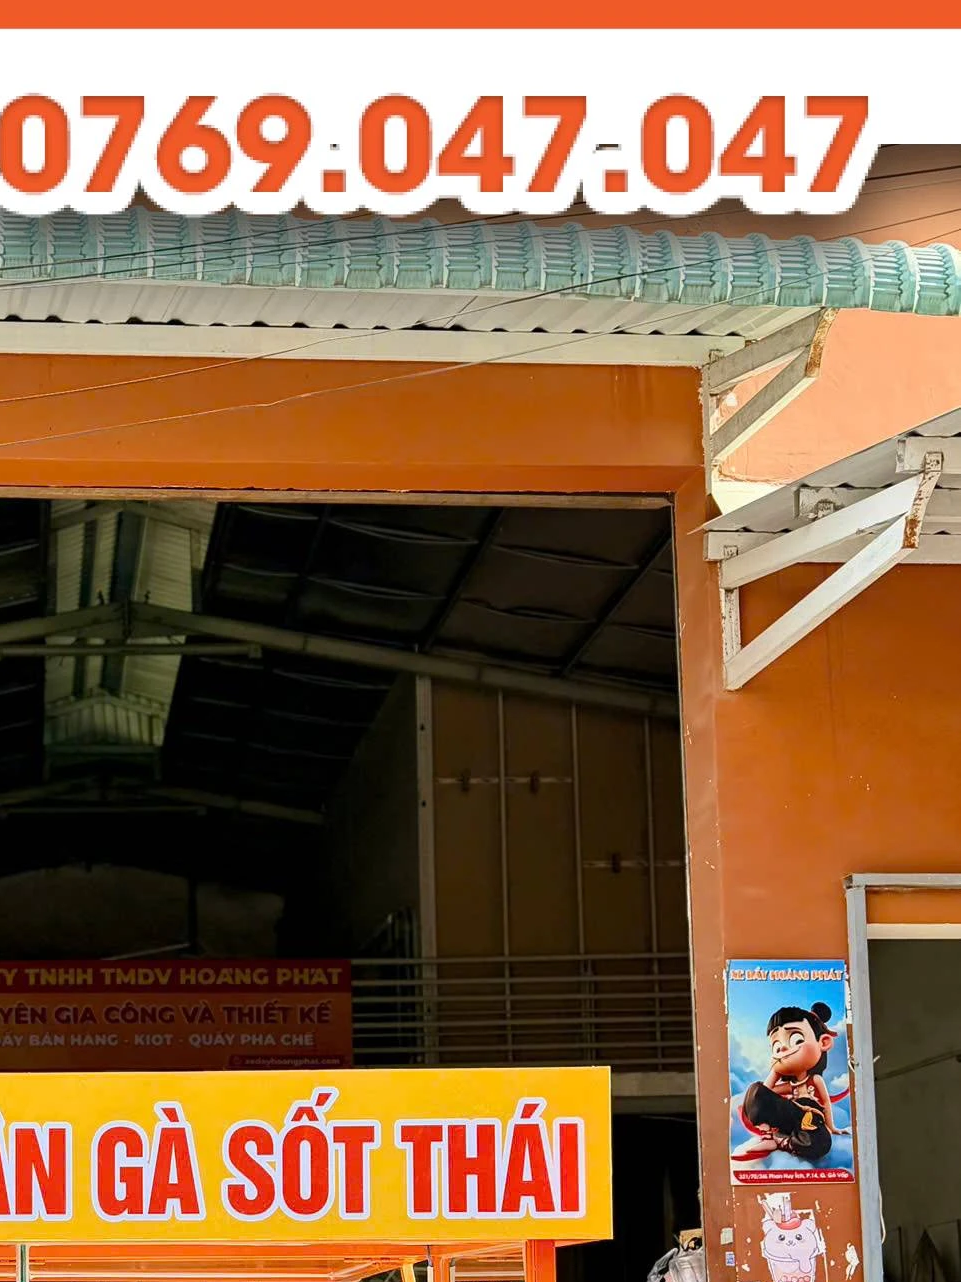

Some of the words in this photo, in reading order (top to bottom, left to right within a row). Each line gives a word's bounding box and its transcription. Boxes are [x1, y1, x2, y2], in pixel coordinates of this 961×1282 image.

[24, 968, 93, 986] TNHH
[101, 968, 172, 986] TMDV
[53, 1006, 98, 1025] GIA
[103, 1000, 175, 1025] CÔNG
[181, 999, 216, 1025] VÀ
[222, 1000, 294, 1025] THIẾT
[298, 1000, 333, 1025] KẾ
[134, 1034, 174, 1046] KIOT
[240, 1034, 276, 1046] PHA
[96, 1107, 202, 1217] GÀ
[226, 1092, 376, 1217] SỐT
[400, 1103, 581, 1214] THÁI
